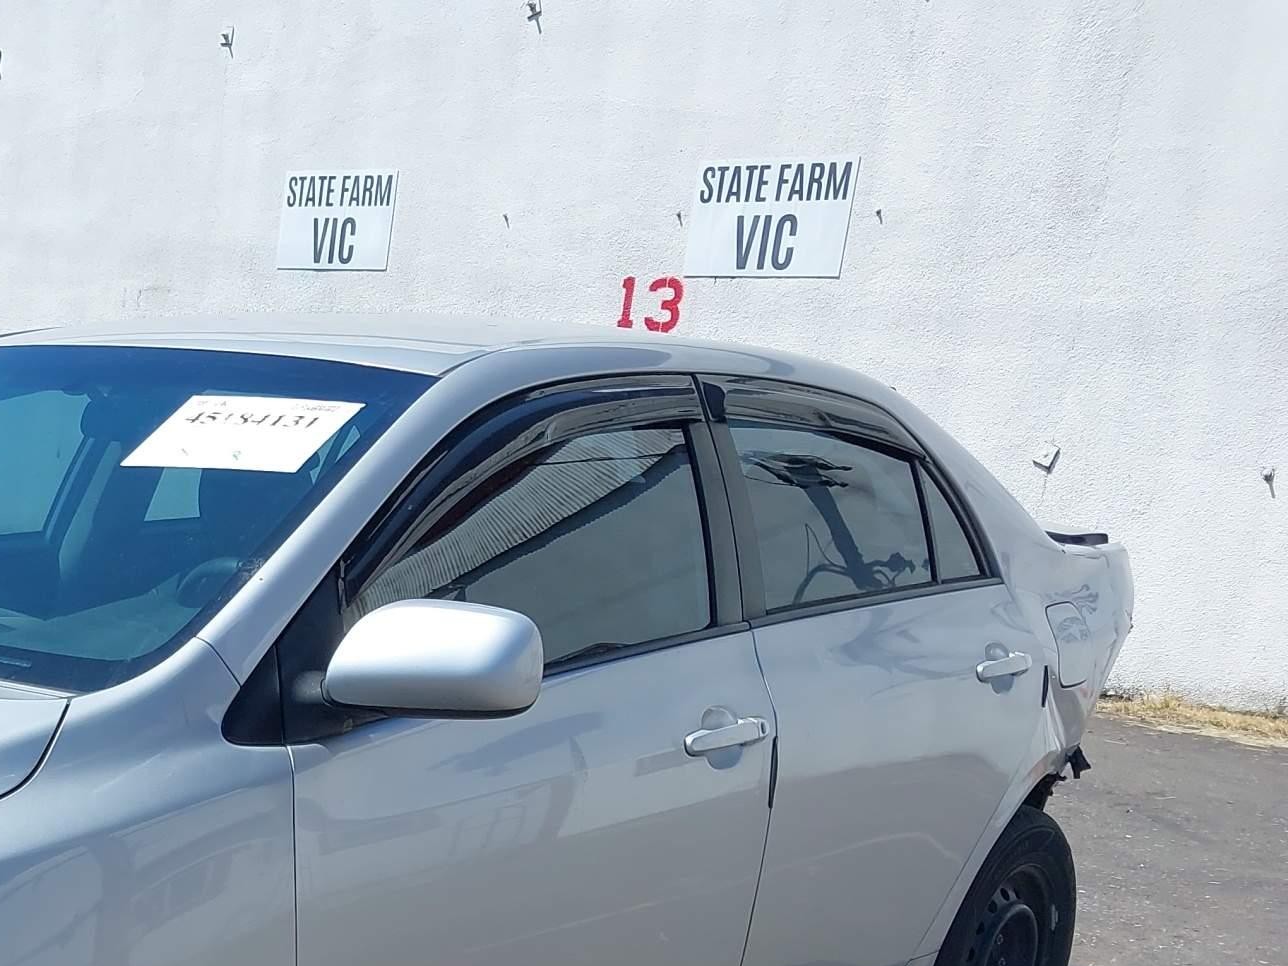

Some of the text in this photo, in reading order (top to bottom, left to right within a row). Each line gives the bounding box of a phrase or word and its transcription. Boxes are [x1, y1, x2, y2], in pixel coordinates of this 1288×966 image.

[287, 174, 393, 207] STATE FARM
[699, 161, 853, 203] STATE FARM
[313, 217, 357, 264] VIC
[735, 213, 798, 271] VIC
[617, 276, 684, 333] 13
